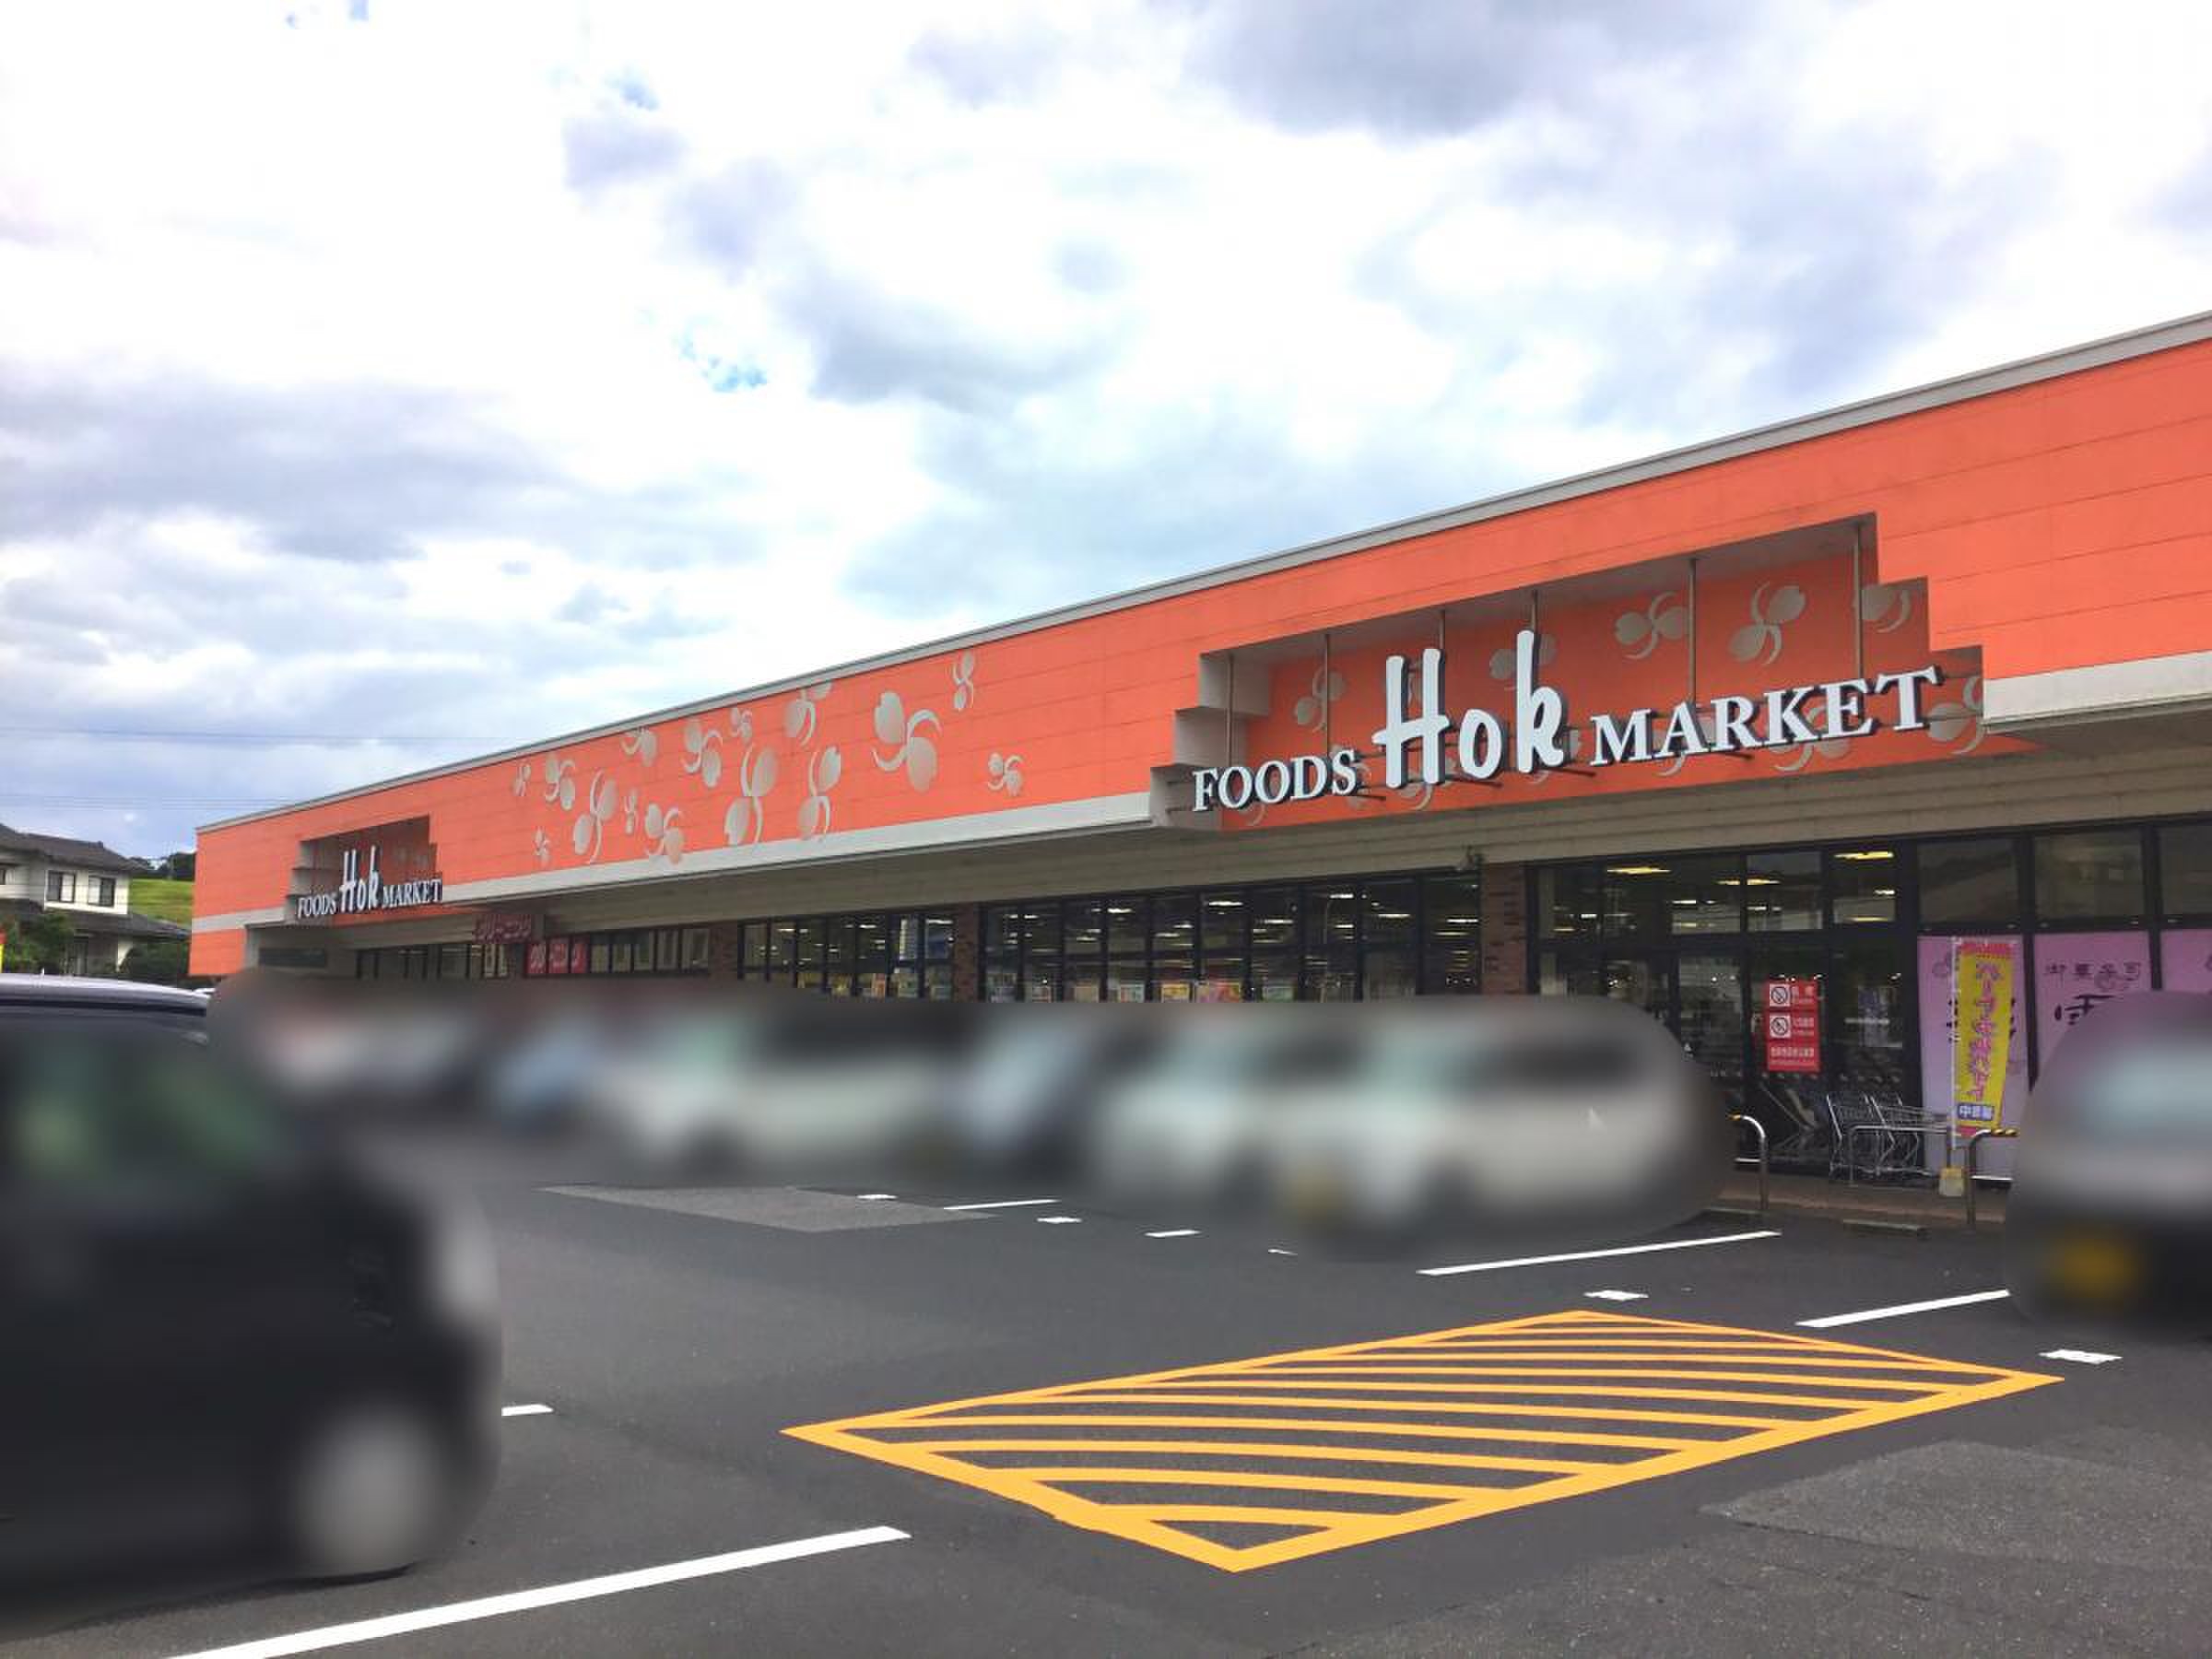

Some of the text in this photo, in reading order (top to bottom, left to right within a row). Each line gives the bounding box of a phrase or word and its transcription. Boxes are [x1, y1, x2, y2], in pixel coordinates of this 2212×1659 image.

[1193, 629, 1938, 811] FOODS Hok MARKET
[297, 844, 442, 919] FOODS Hok MARKET
